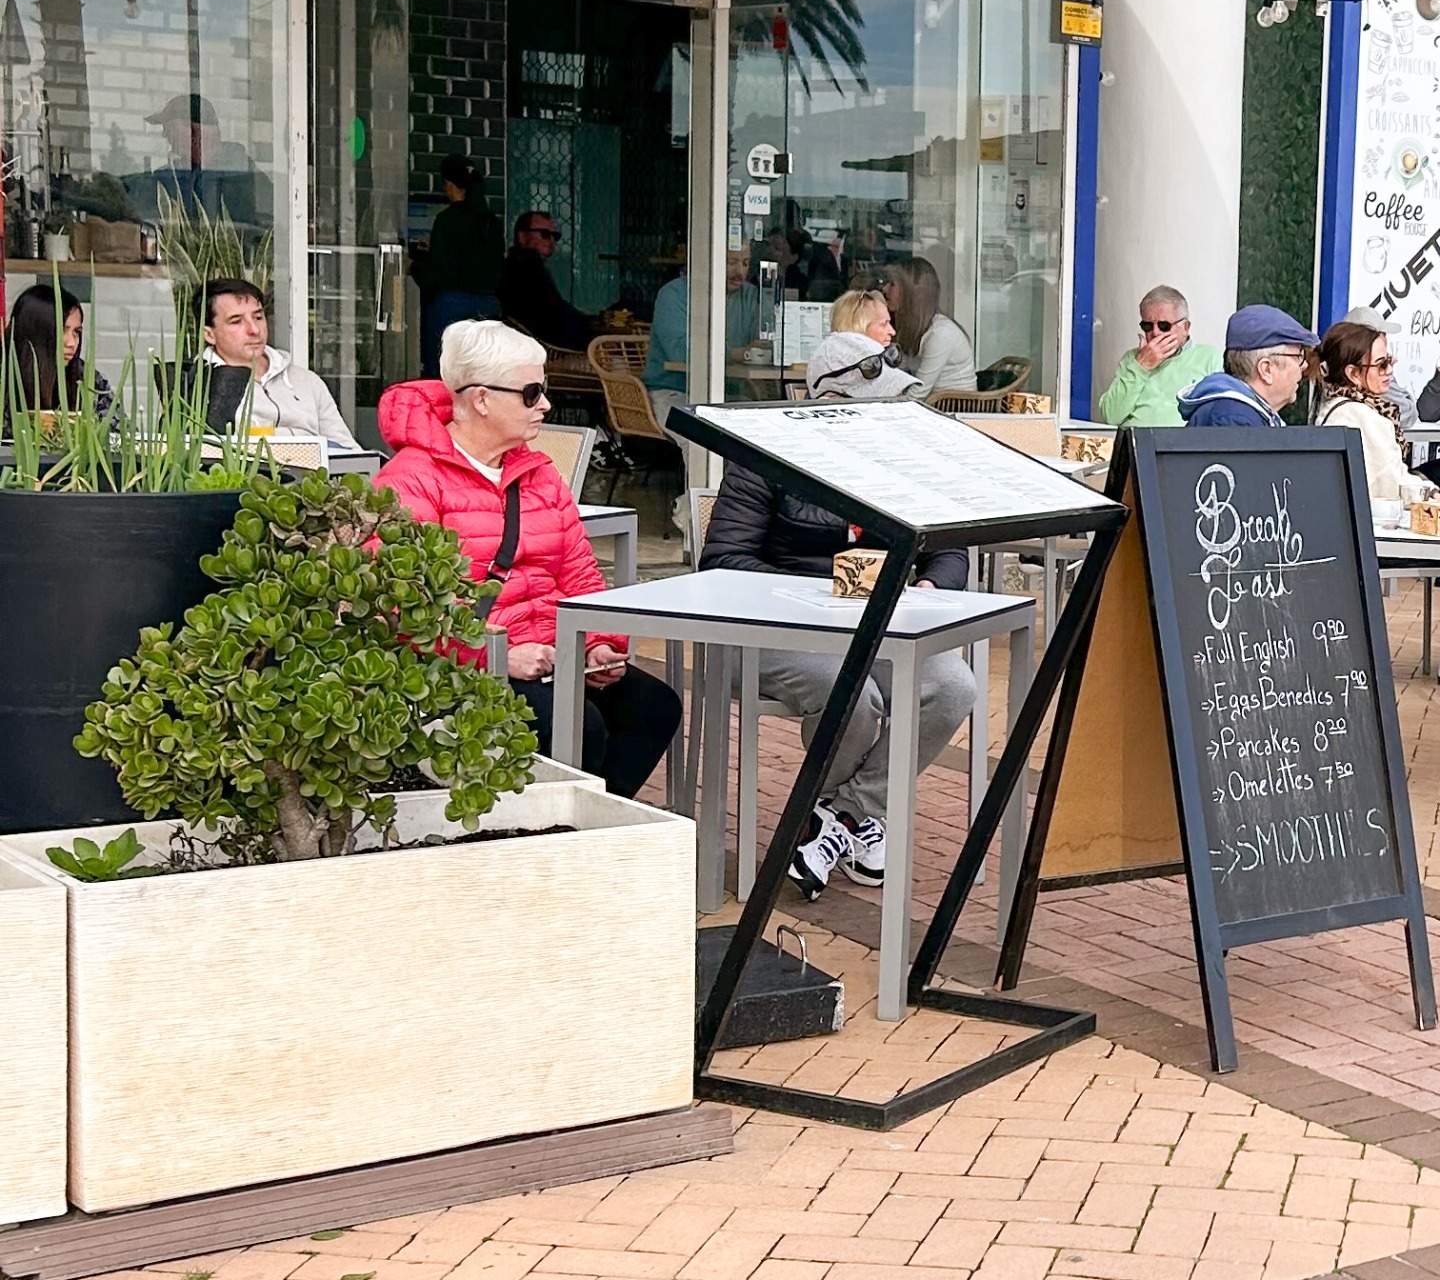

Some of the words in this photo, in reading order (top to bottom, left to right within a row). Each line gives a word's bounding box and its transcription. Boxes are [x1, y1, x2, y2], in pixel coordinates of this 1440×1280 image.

[1368, 109, 1432, 136] CROISSANTS
[747, 195, 768, 205] VISA
[1363, 191, 1424, 230] Coffee
[1204, 631, 1236, 664] Full
[1239, 625, 1296, 674] English
[1220, 724, 1300, 760] Pancakes
[1228, 757, 1314, 801] Omelettes
[1236, 808, 1389, 871] SMOOTHIS
